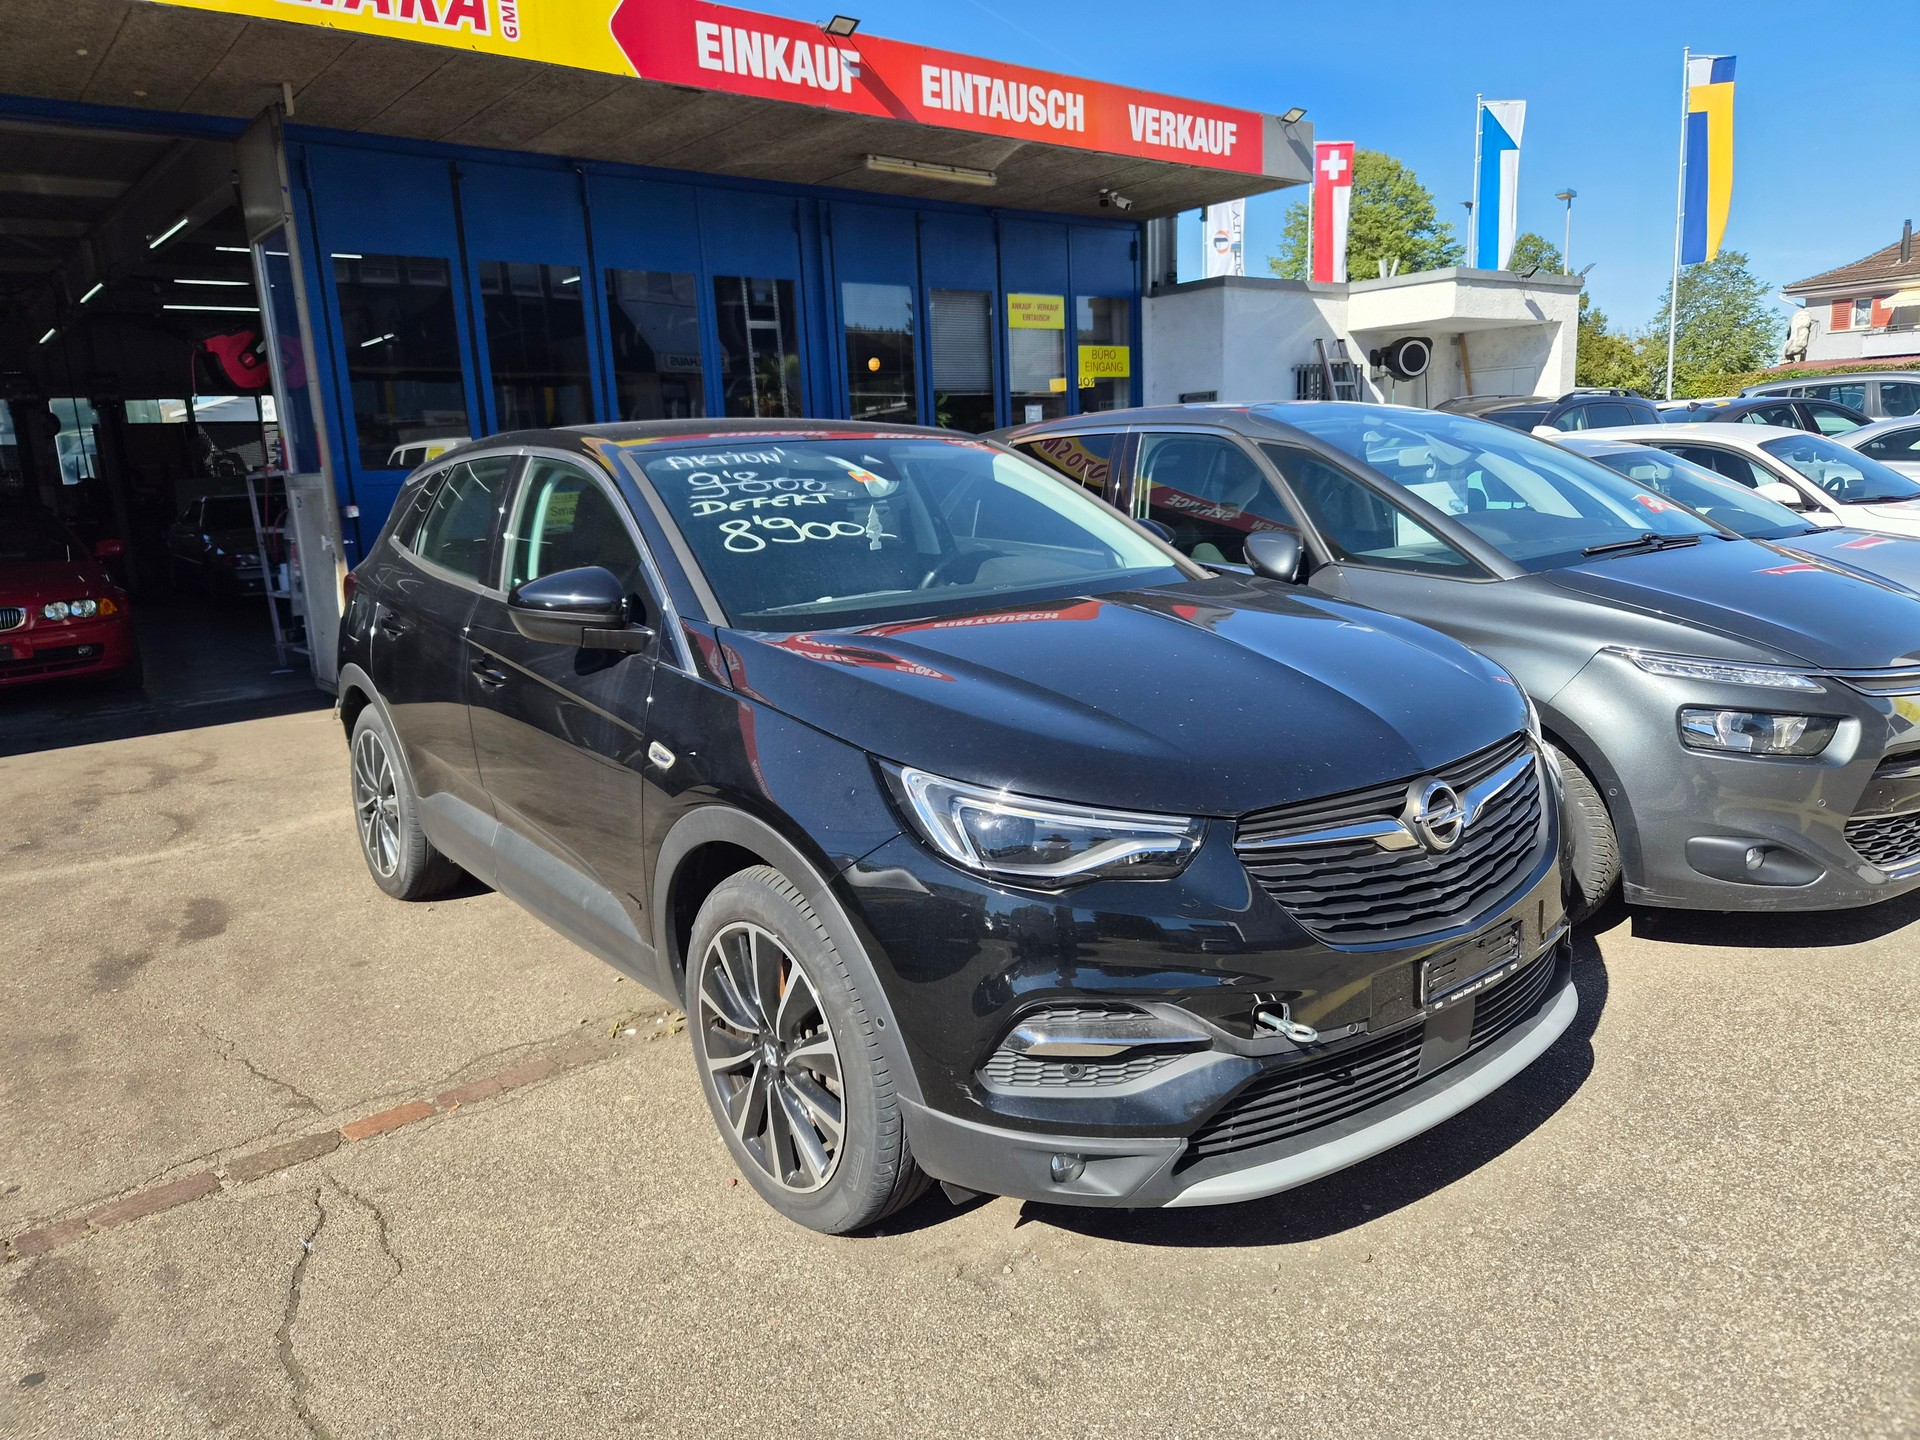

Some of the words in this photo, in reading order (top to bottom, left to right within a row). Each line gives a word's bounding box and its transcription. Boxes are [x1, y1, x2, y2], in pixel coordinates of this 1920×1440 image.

[695, 20, 861, 94] EINKAUF
[921, 64, 1085, 132] EINTAUSCH
[1128, 103, 1237, 156] VERKAUF
[1012, 302, 1032, 310] ANKAUF
[1091, 348, 1116, 359] BÜRO
[1085, 361, 1123, 372] EINGANG
[690, 493, 834, 516] DEFEKT
